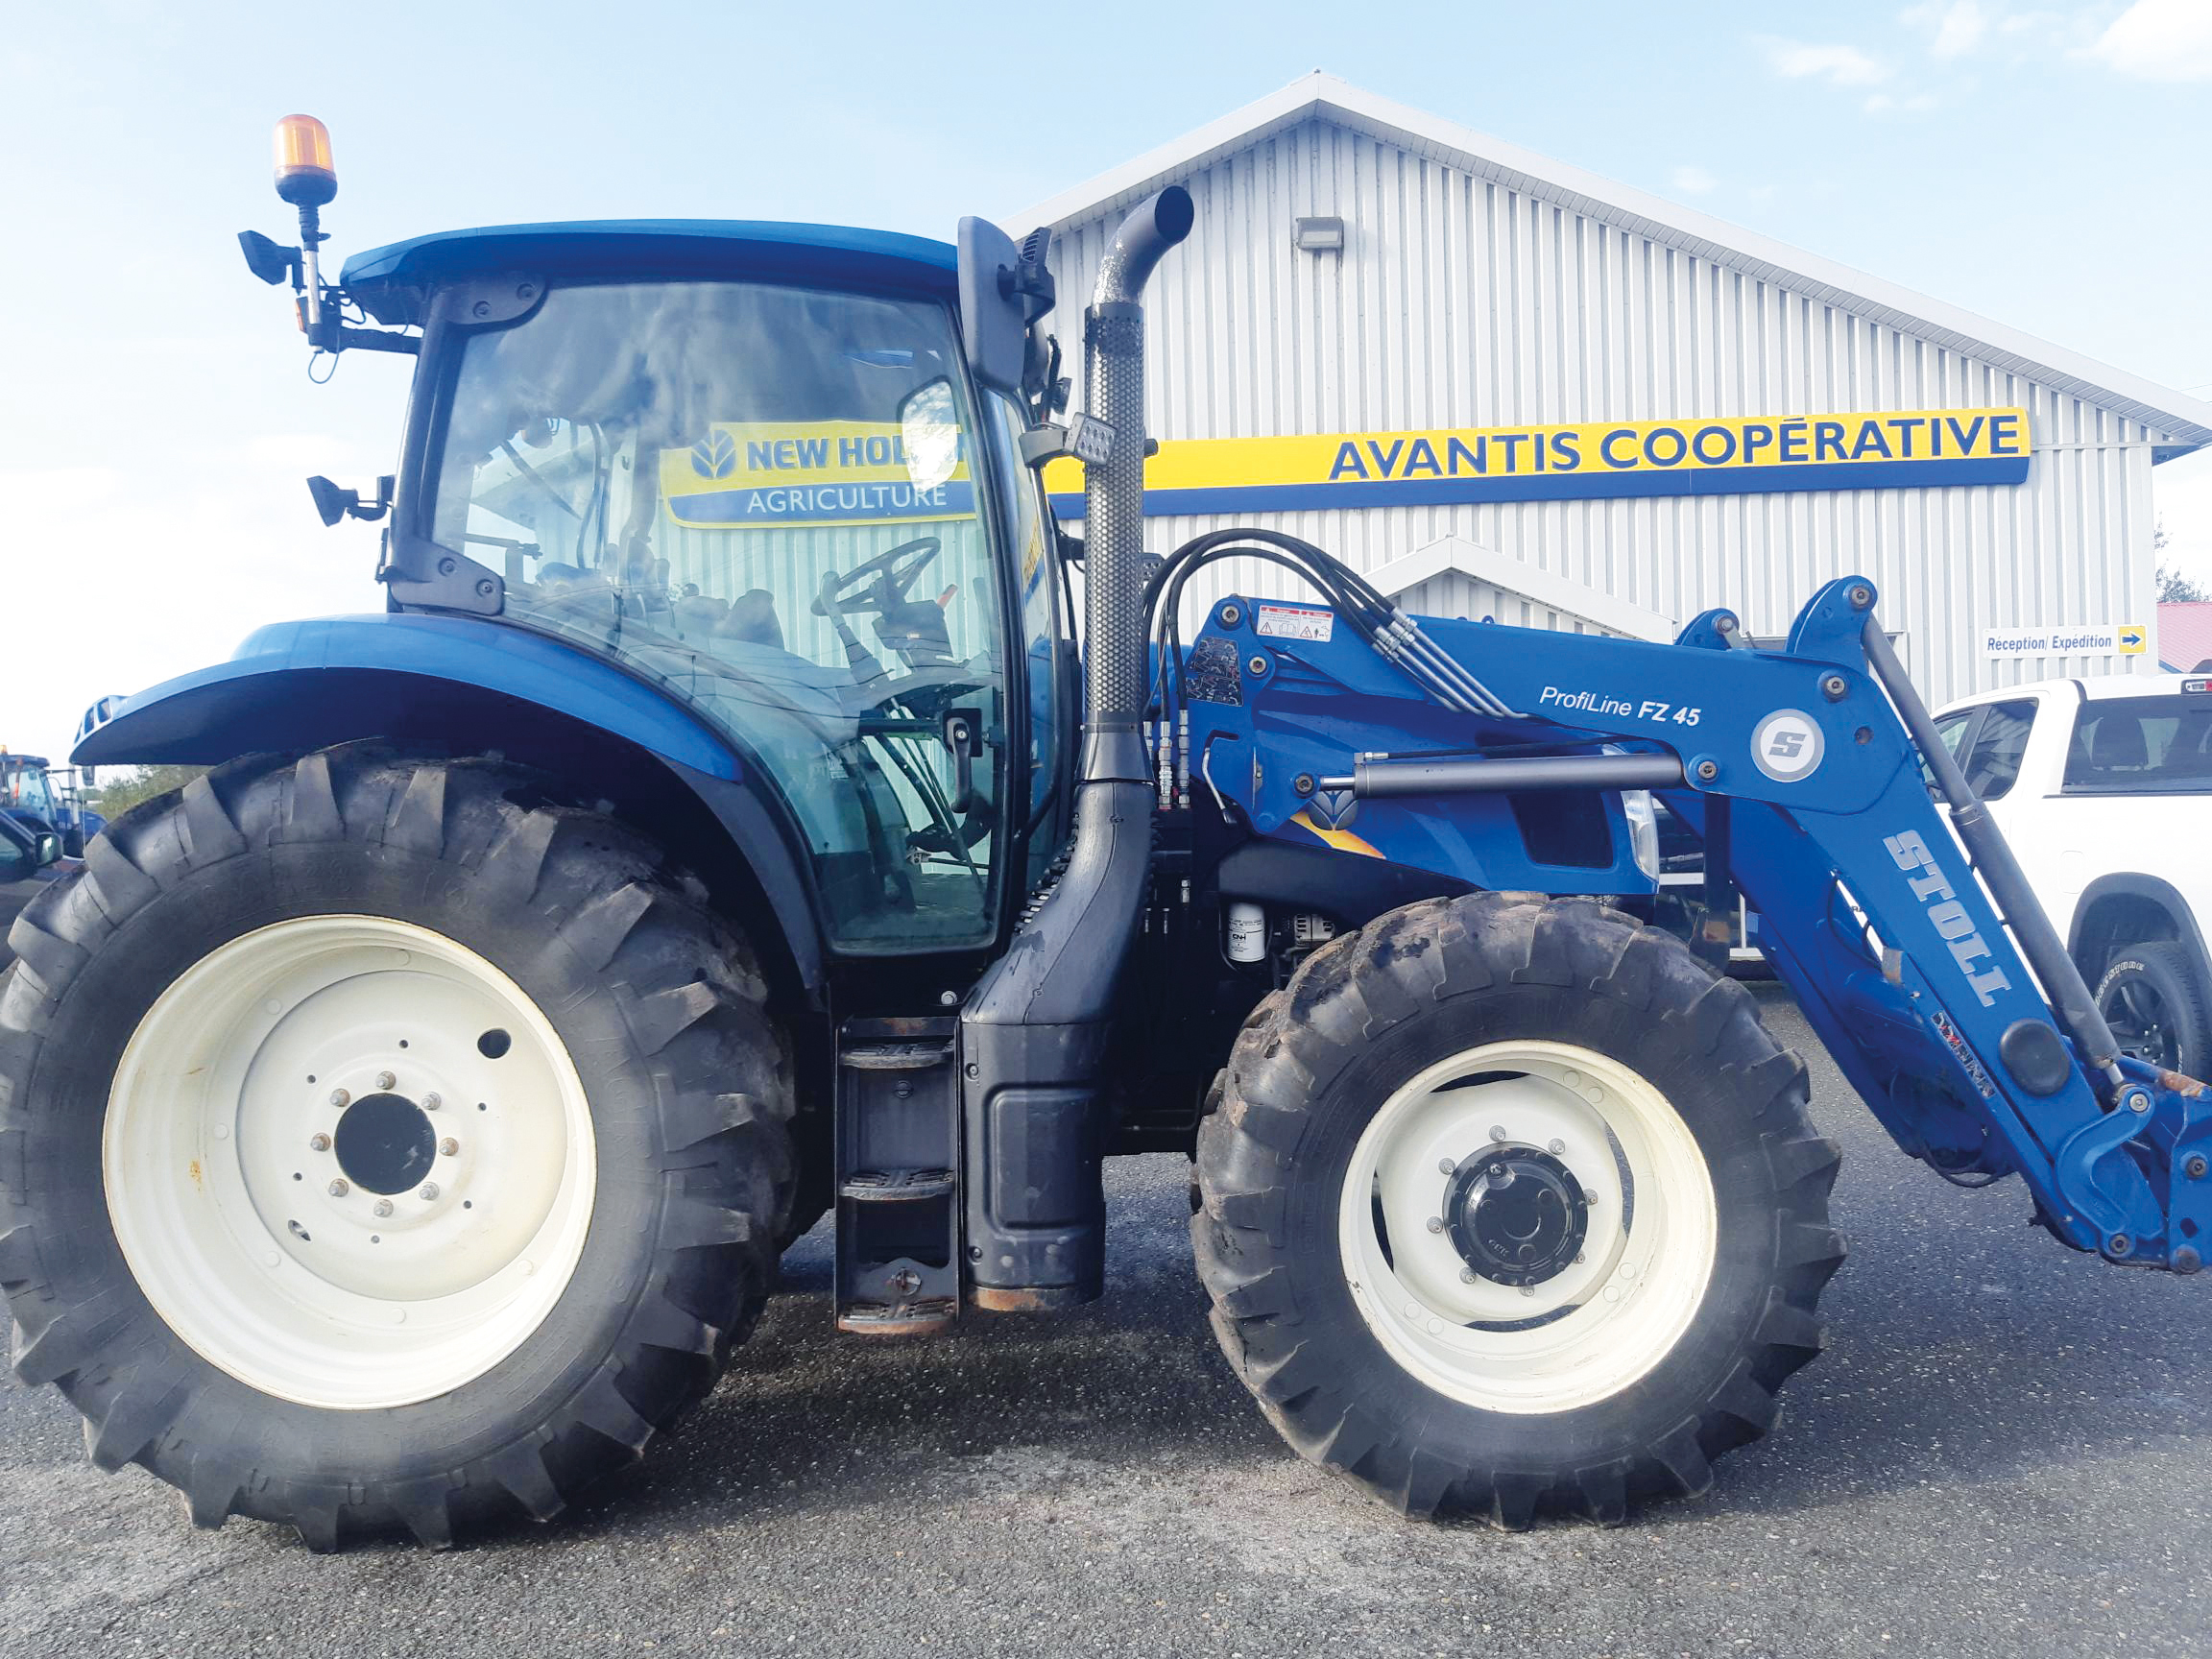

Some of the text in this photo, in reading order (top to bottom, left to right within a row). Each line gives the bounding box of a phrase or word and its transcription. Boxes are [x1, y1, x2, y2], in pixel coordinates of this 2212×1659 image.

[747, 437, 830, 471] NEW
[1328, 415, 2018, 481] AVANTIS COOPÉRATIVE
[747, 484, 948, 514] AGRICULTURE
[2052, 634, 2112, 652] Expédition
[1539, 685, 1701, 727] ProfiLine FZ 45
[1883, 829, 2012, 1008] STOLL
